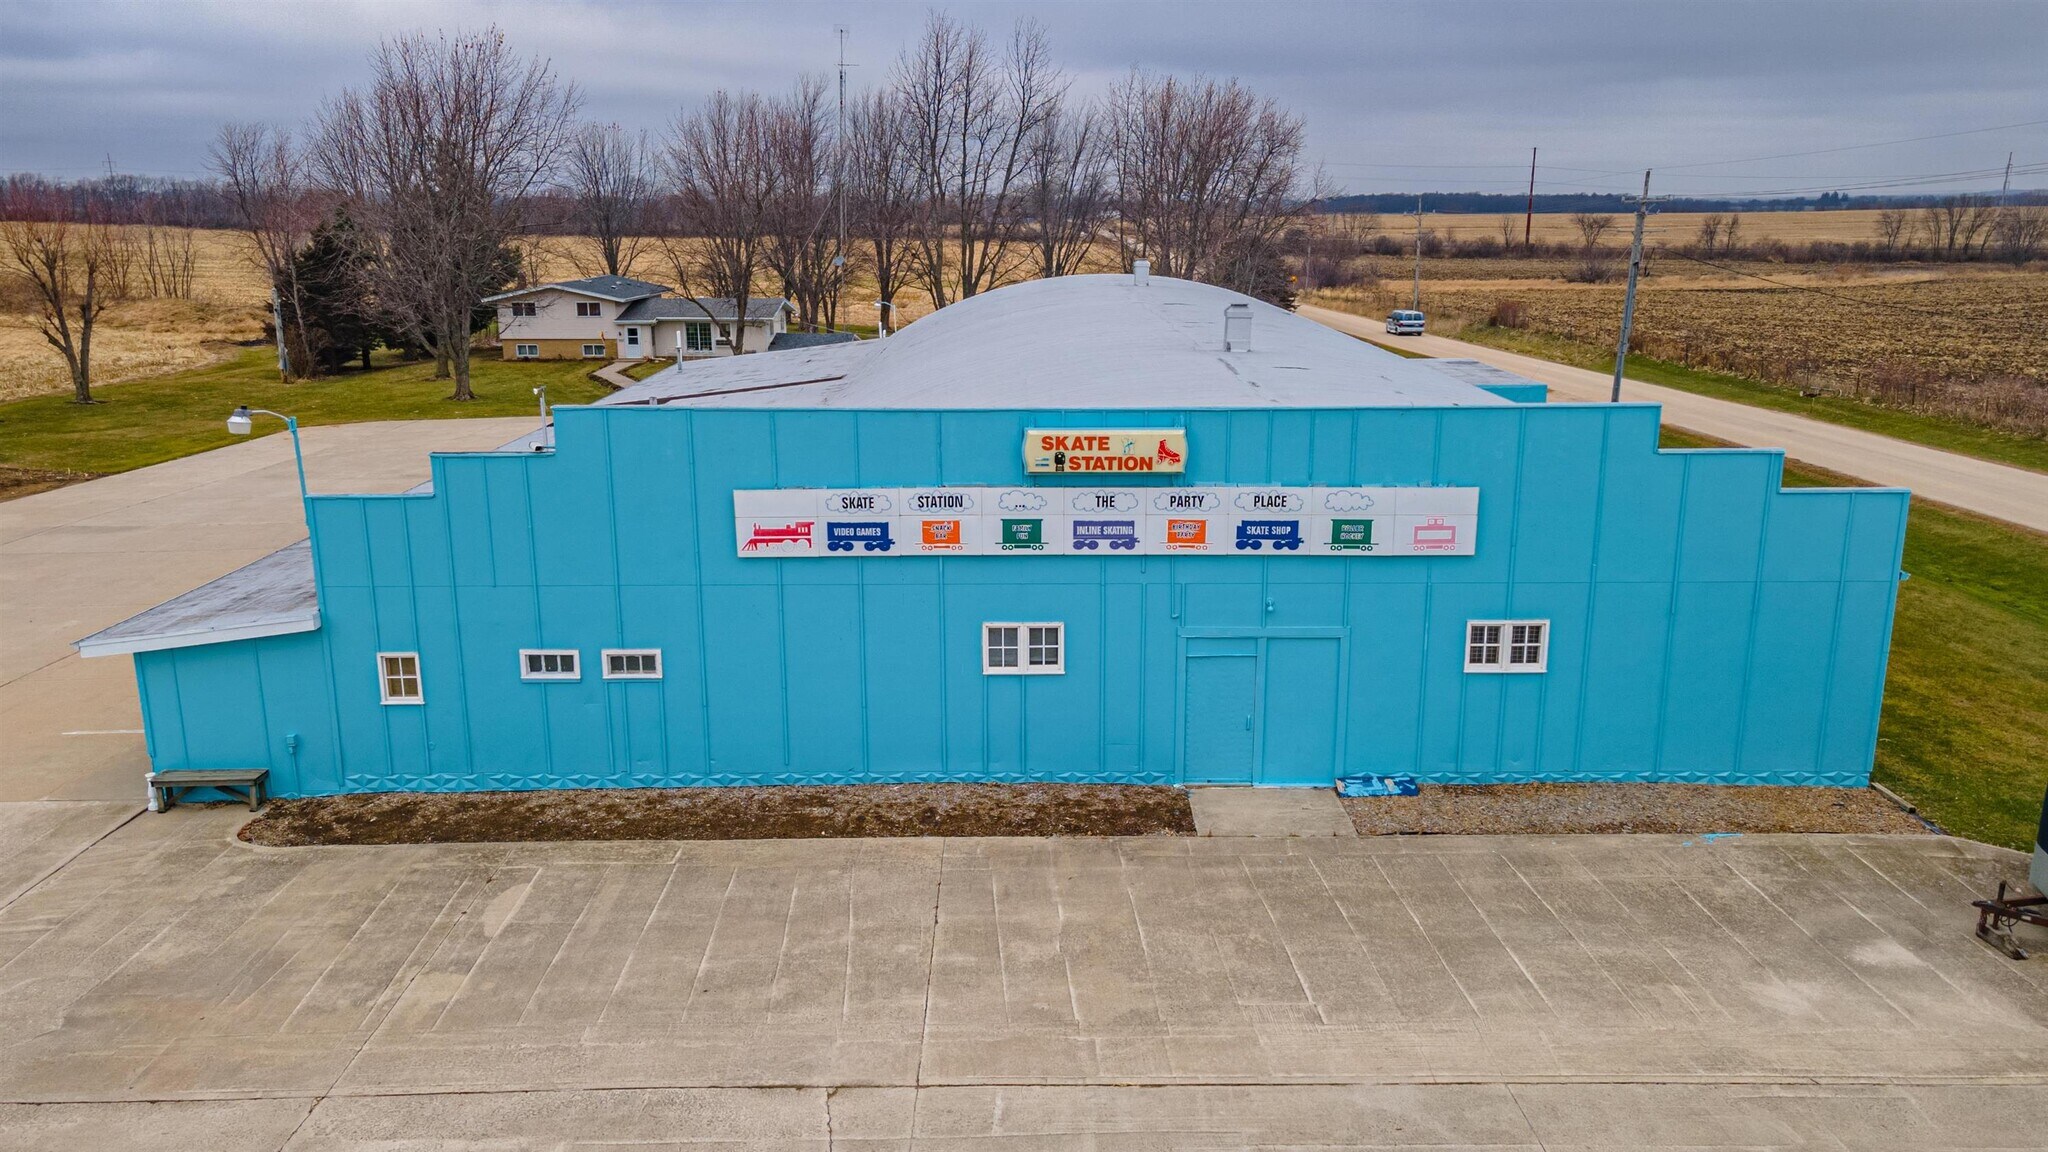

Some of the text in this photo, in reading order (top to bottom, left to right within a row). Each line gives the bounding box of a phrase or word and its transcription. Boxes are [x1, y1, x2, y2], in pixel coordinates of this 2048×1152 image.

[1041, 435, 1110, 451] SKATE
[1068, 456, 1153, 471] STATION
[842, 496, 875, 509] SKATE
[917, 495, 963, 508] STATION
[1095, 495, 1115, 508] THE
[1170, 495, 1205, 508] PARTY
[1253, 495, 1288, 508] PLACE
[833, 527, 882, 536] VIDEO GAMES
[1076, 525, 1133, 535] INLINE SKATING
[1172, 523, 1201, 531] BIRTHDAY
[1246, 526, 1291, 535] SKATE SHOP
